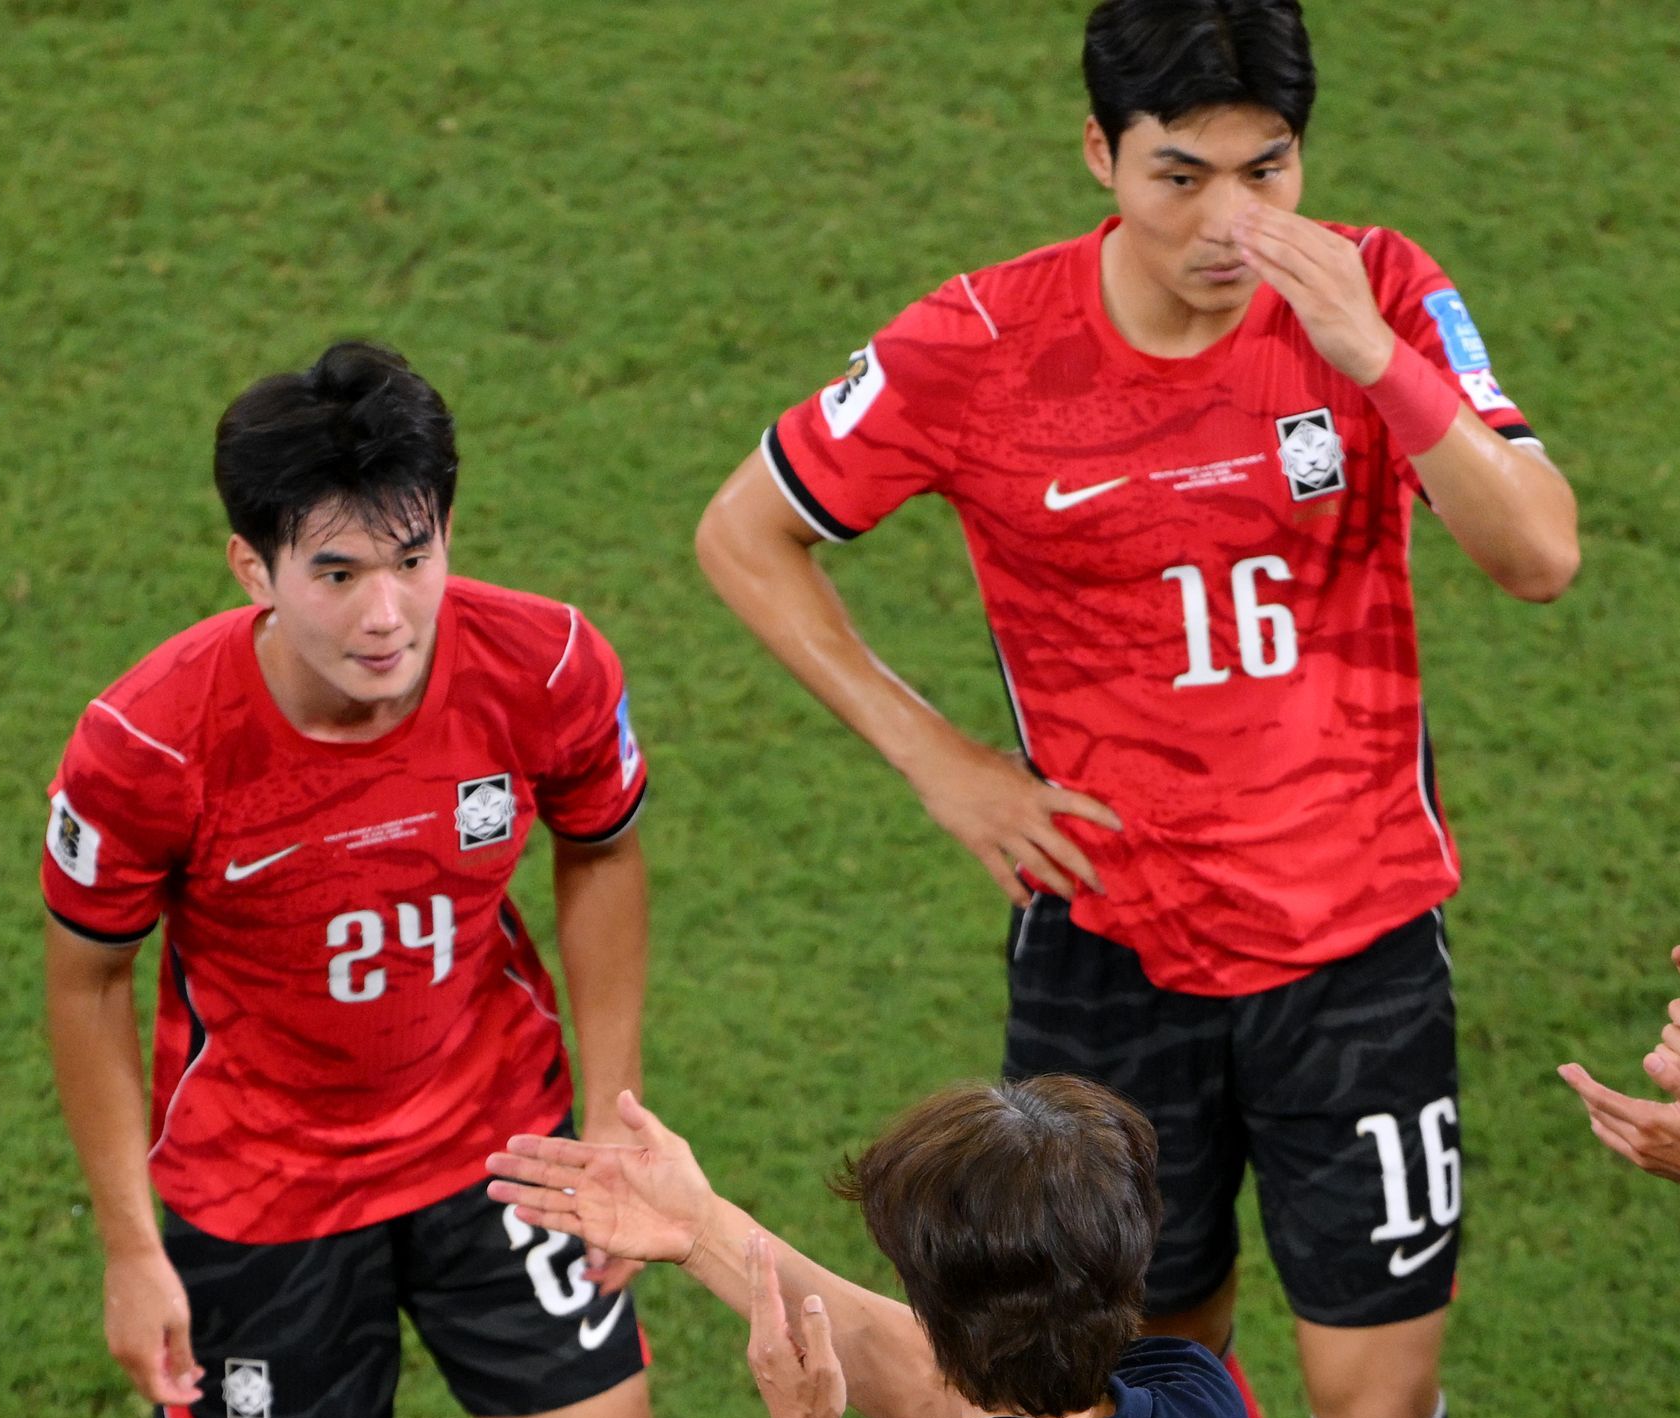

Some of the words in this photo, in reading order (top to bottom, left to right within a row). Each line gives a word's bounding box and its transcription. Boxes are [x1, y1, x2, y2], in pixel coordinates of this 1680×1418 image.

[1162, 555, 1299, 691] 16
[325, 895, 457, 1004] 24
[1356, 1096, 1461, 1243] 16
